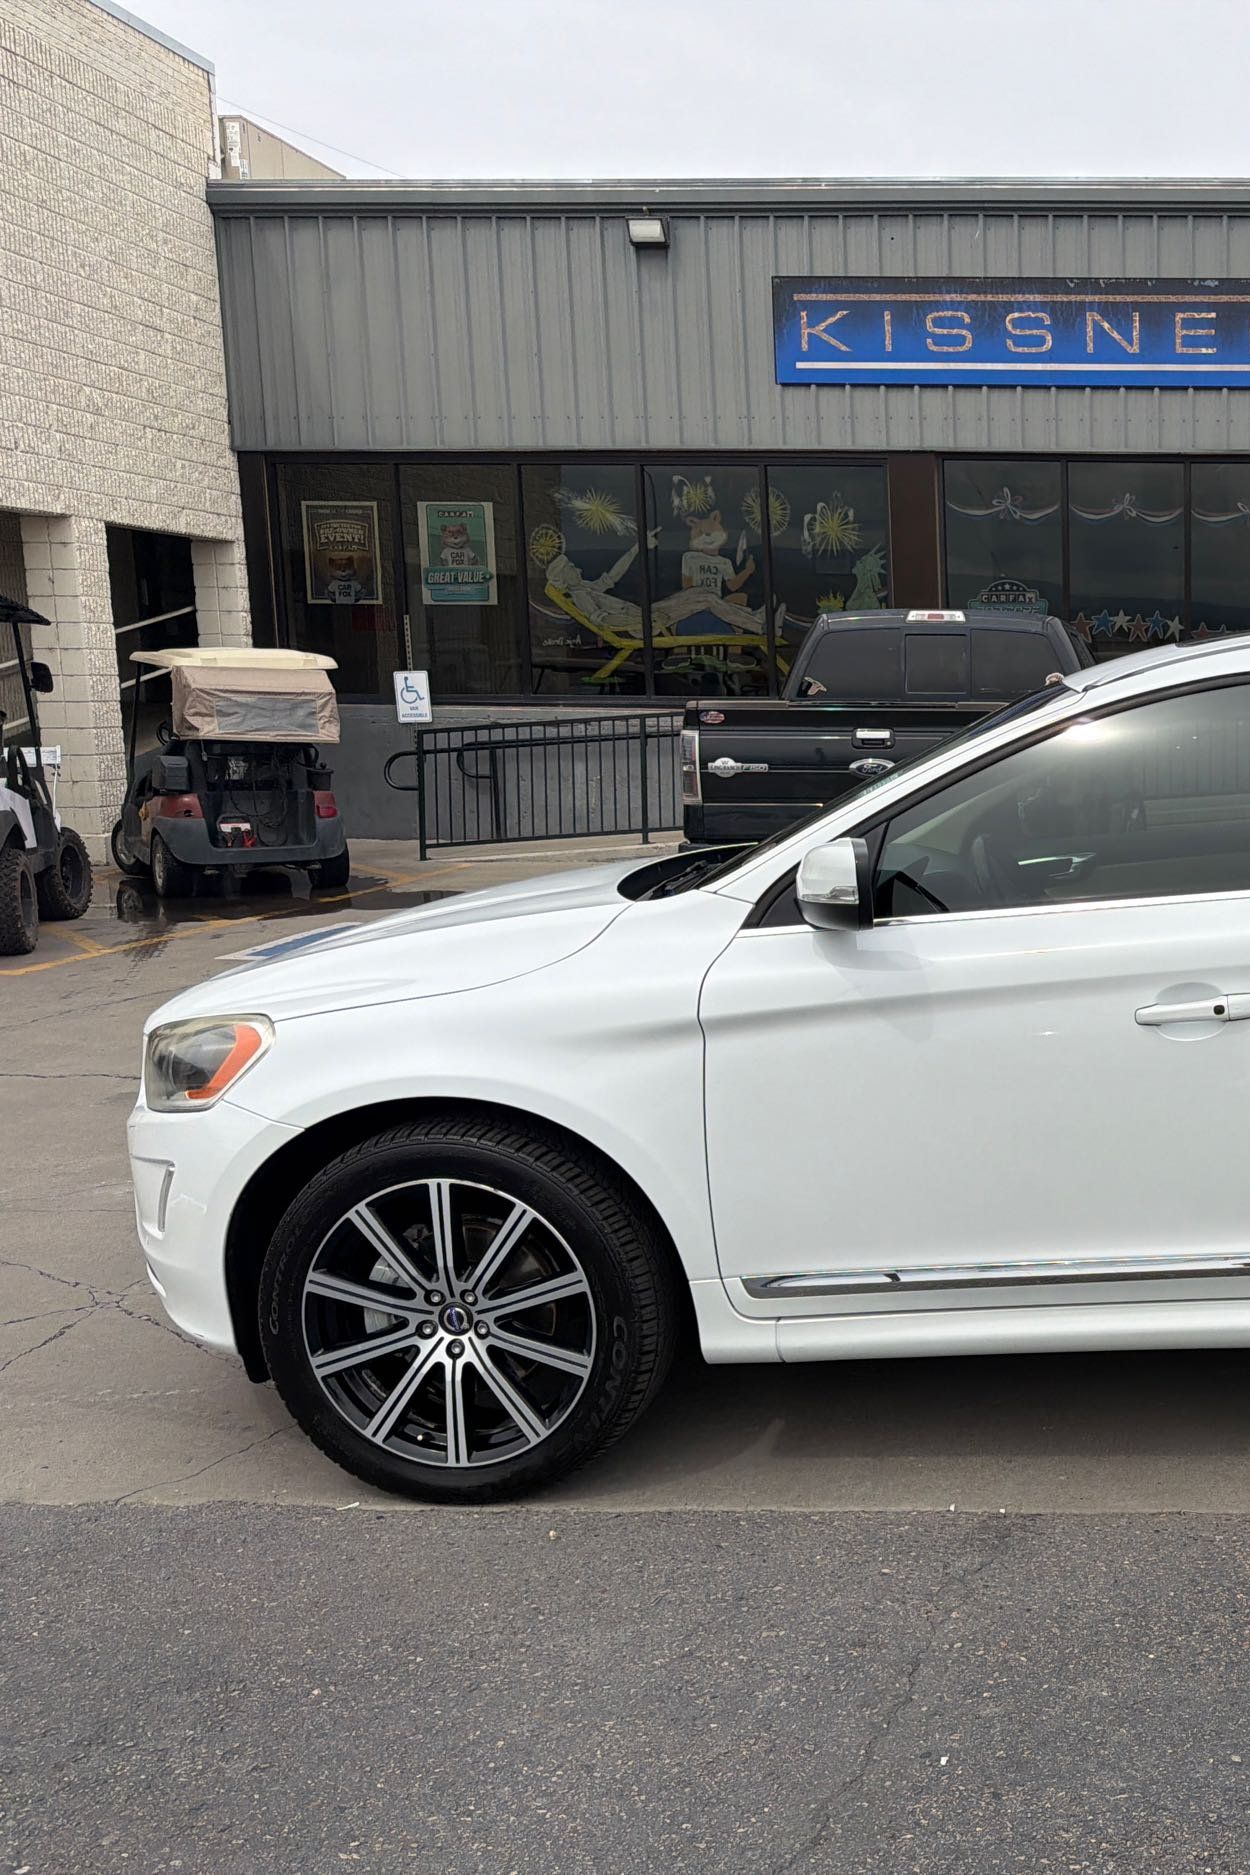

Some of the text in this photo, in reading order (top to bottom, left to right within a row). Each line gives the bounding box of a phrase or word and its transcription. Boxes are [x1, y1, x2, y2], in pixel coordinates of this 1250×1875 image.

[319, 533, 365, 543] EVENT!
[427, 571, 485, 584] GREAT VALUE
[981, 593, 1035, 604] CARFAX
[862, 763, 883, 773] Ford
